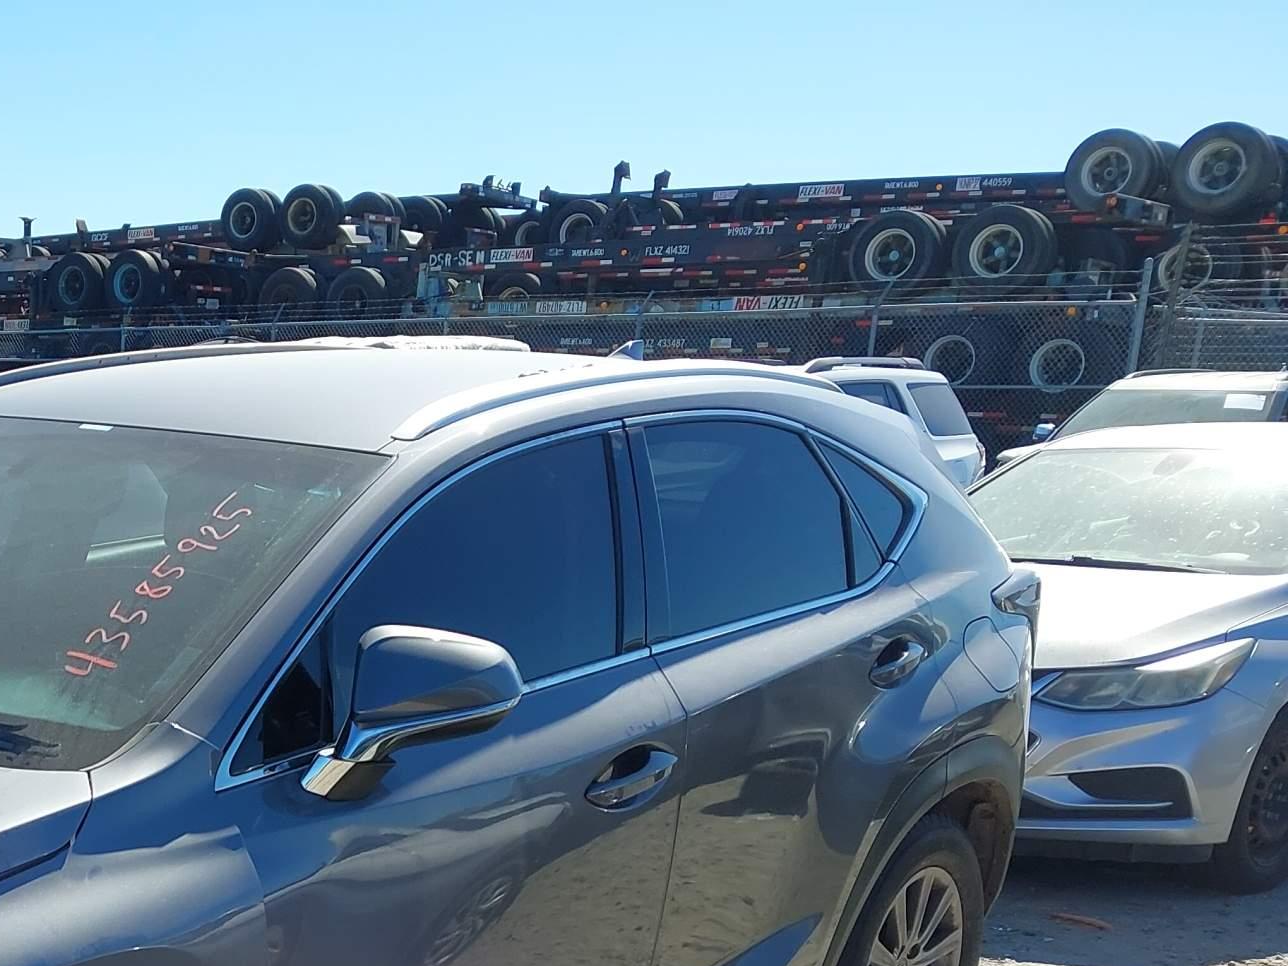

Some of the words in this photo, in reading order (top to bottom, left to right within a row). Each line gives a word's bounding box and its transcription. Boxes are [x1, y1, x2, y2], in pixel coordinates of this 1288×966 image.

[982, 178, 1012, 187] 440559
[799, 184, 843, 197] FLEXI-VAN
[727, 226, 753, 237] 420614
[755, 225, 774, 236] FLXZ
[491, 248, 532, 262] FLEXI-VAN
[645, 246, 664, 256] FLXZ
[665, 245, 690, 255] 414321
[734, 296, 801, 311] FLEXI-VAN
[657, 338, 685, 349] 433487
[65, 491, 253, 676] 43585925
